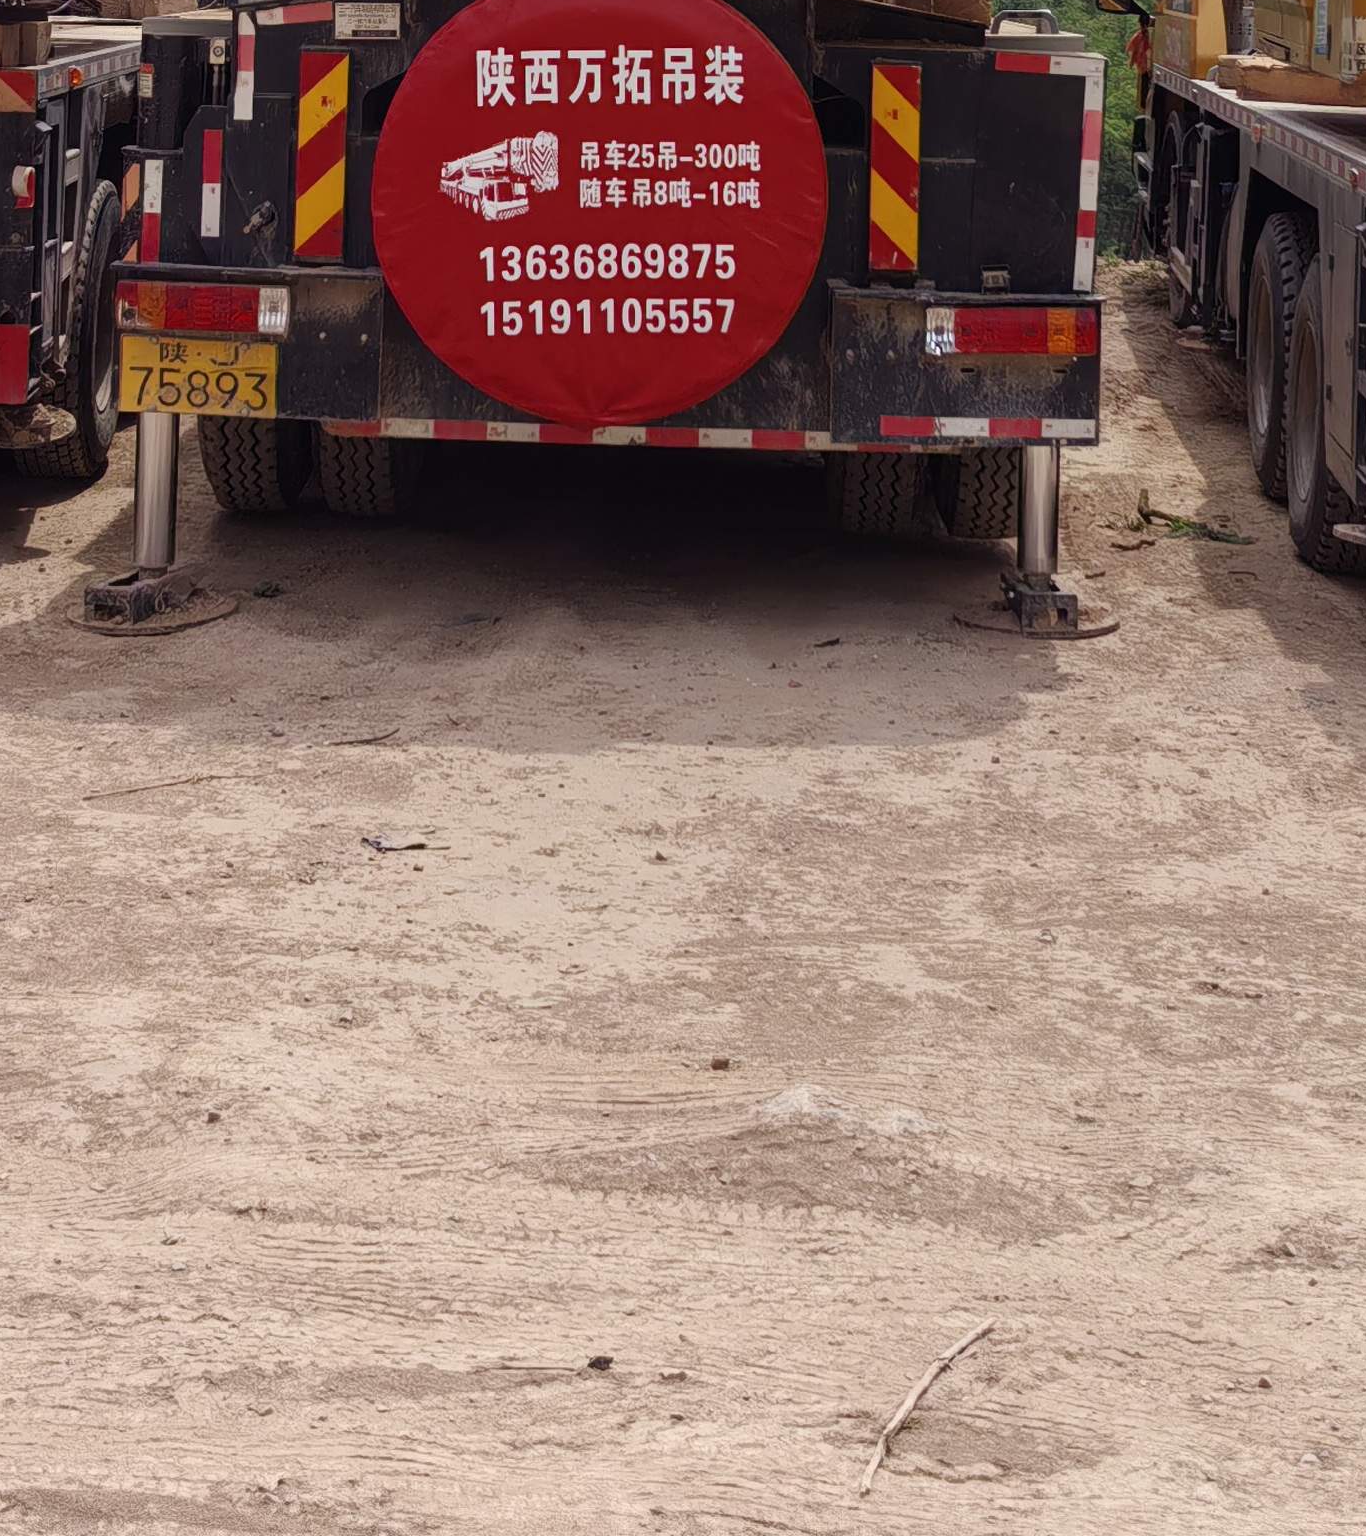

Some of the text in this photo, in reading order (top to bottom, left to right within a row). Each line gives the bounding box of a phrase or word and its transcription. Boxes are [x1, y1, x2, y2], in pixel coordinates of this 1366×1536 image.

[475, 43, 745, 108] 陕西万拓吊装
[479, 243, 737, 282] 13636869875
[479, 297, 736, 337] 15191105557
[128, 365, 269, 412] 75893
